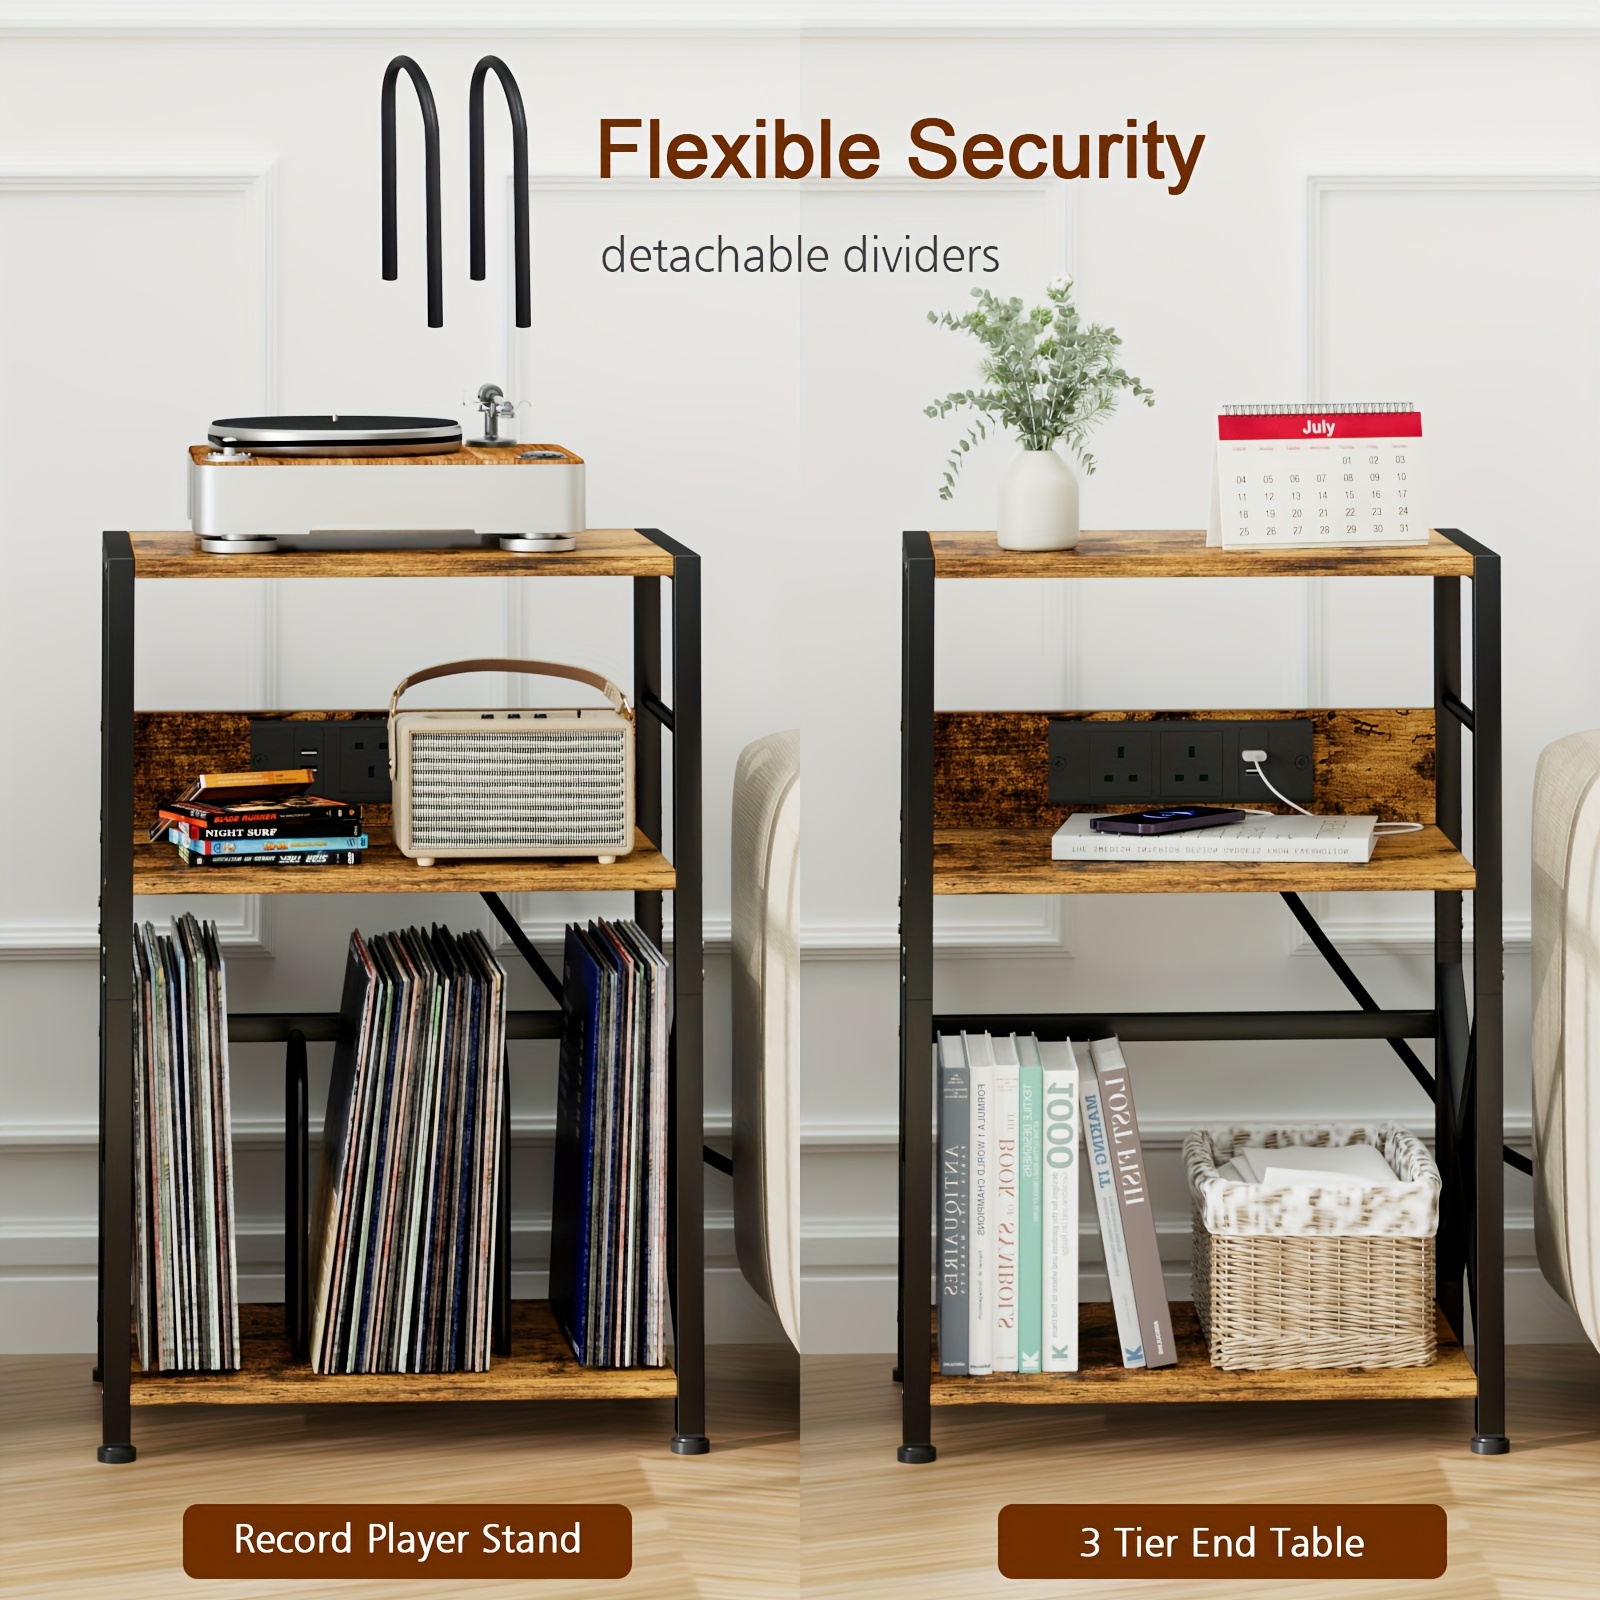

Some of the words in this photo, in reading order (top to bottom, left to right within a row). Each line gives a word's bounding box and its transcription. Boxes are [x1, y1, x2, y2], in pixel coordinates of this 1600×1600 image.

[1302, 419, 1336, 437] July
[1342, 456, 1351, 465] 01
[1368, 455, 1379, 465] 02
[1395, 455, 1406, 464] 03
[1236, 475, 1246, 484] 04
[1263, 474, 1274, 484] 05
[1289, 474, 1300, 483] 06
[1316, 473, 1326, 483] 07
[1343, 473, 1354, 482] 08
[1369, 473, 1380, 482] 09
[1397, 472, 1407, 481] 10
[1238, 492, 1246, 501] 11
[1265, 492, 1274, 501] 12
[1291, 491, 1301, 501] 13
[1318, 491, 1328, 500] 14
[1345, 490, 1355, 499] 15
[1372, 490, 1381, 499] 16
[1398, 489, 1407, 498] 17
[1239, 510, 1249, 519] 18
[1266, 509, 1275, 518] 19
[1292, 509, 1302, 518] 20
[1318, 508, 1328, 517] 21
[1345, 507, 1355, 517] 22
[1372, 507, 1382, 516] 23
[1398, 506, 1409, 515] 24
[1239, 527, 1250, 537] 25
[1266, 526, 1277, 536] 26
[1293, 525, 1303, 535] 27
[1319, 525, 1330, 535] 28
[1346, 524, 1357, 534] 29
[1373, 524, 1384, 533] 30
[1399, 524, 1409, 533] 31
[205, 829, 244, 838] NIGHT
[247, 828, 278, 837] SURF
